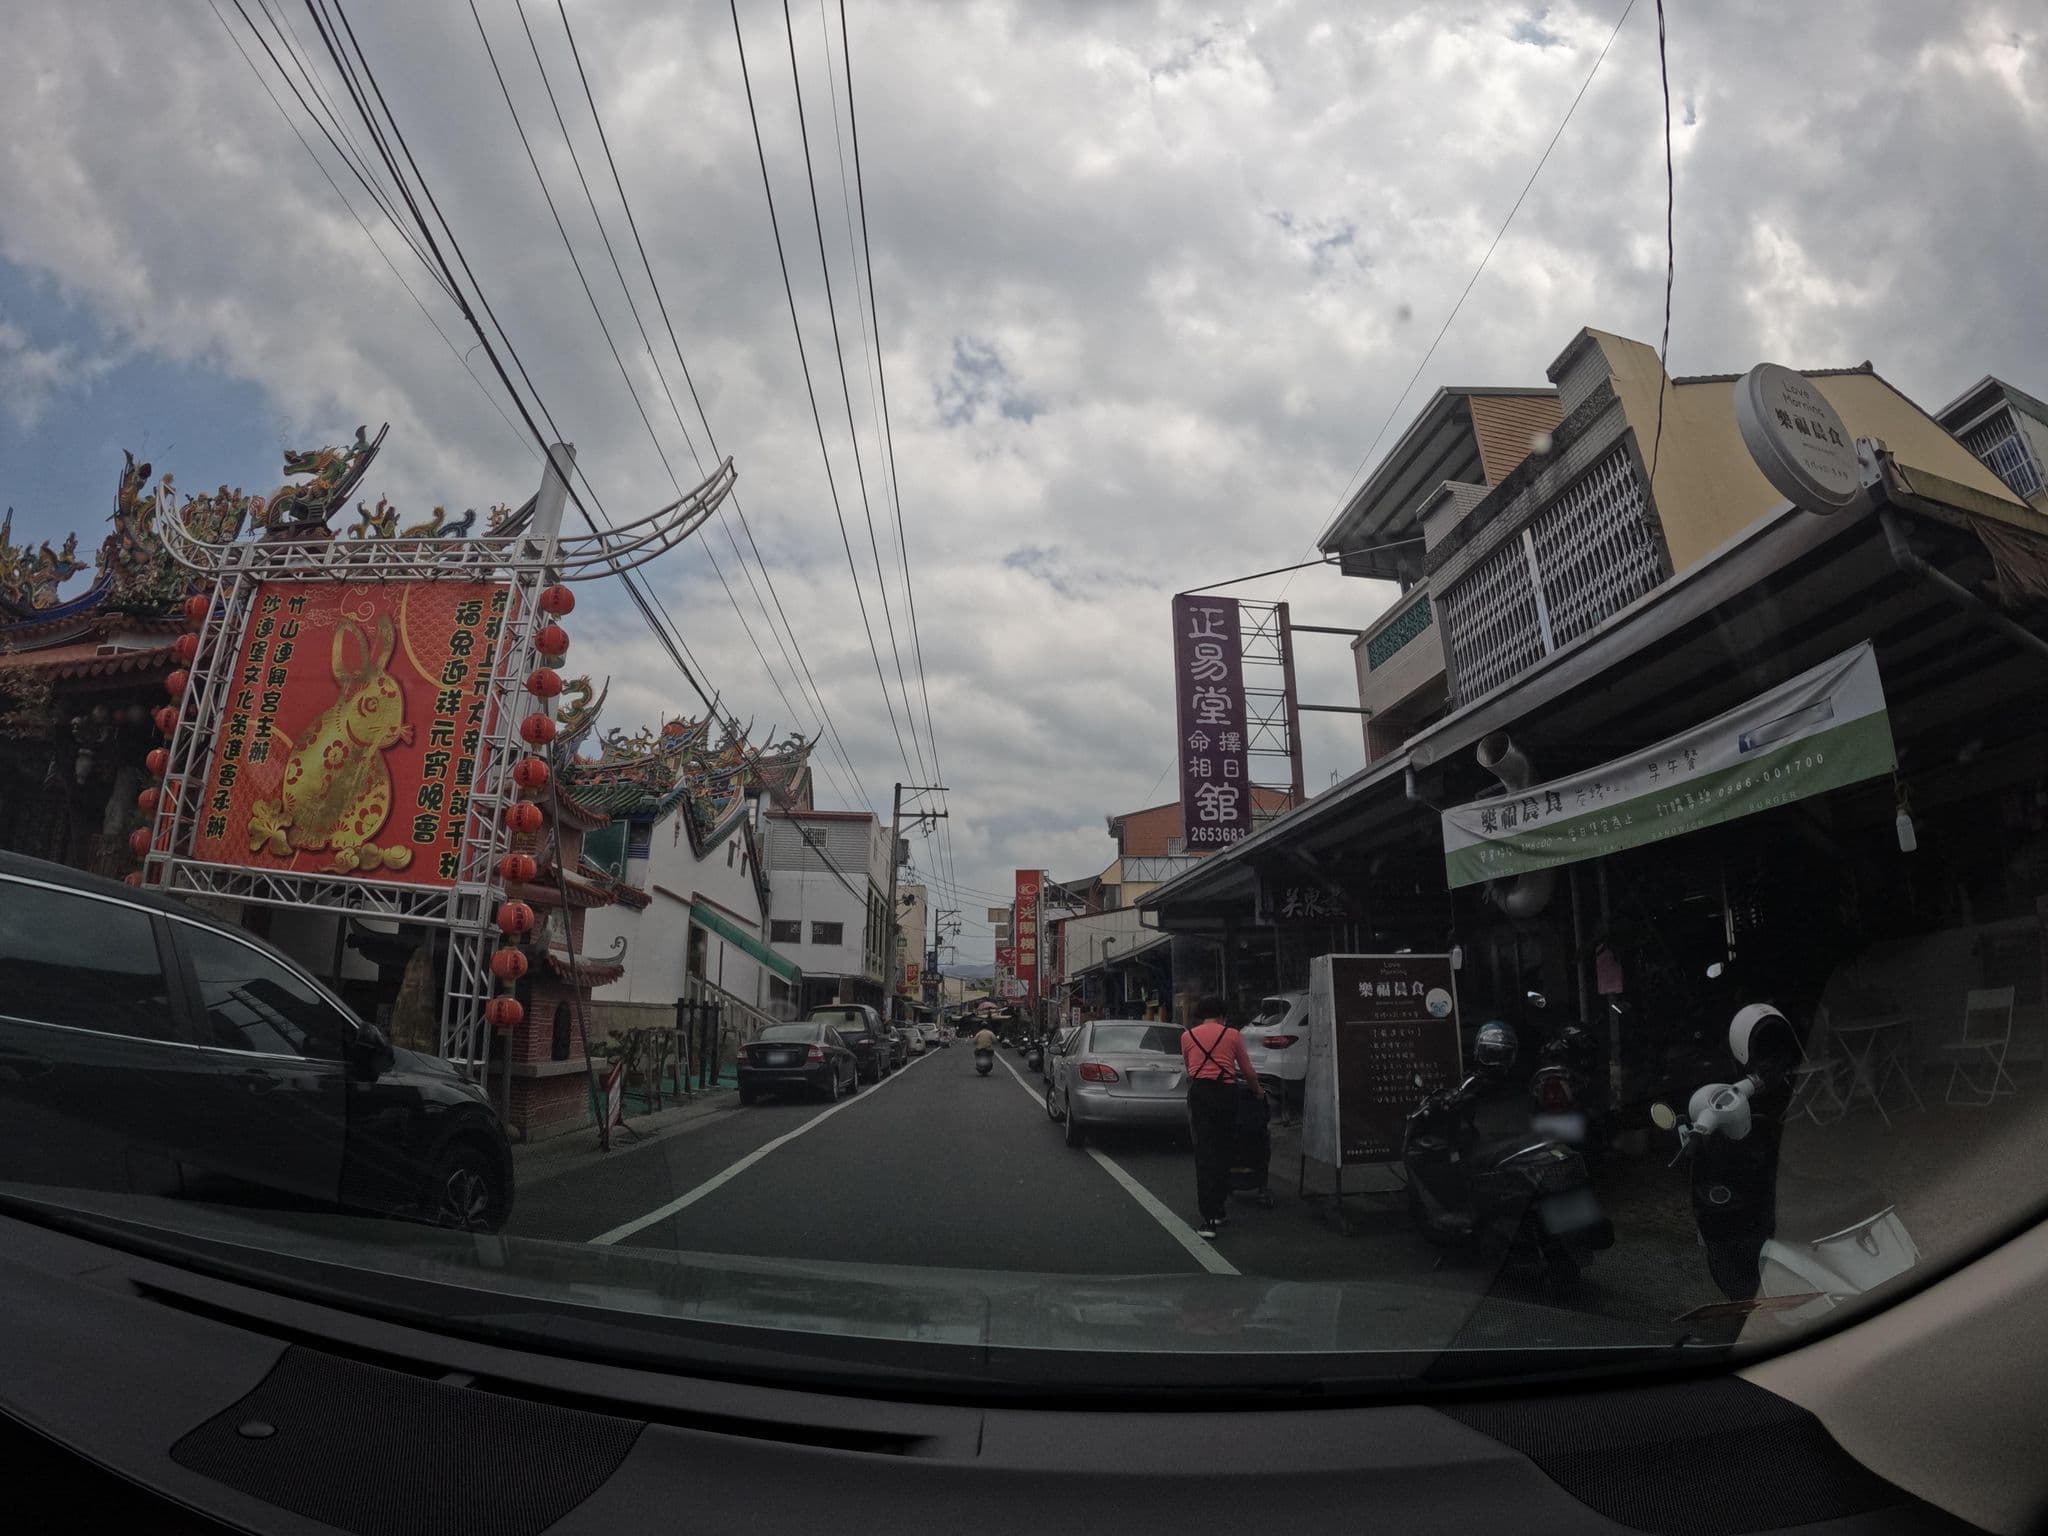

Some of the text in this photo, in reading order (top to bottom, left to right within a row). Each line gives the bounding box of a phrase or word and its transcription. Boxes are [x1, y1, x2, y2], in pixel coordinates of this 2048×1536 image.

[1774, 407, 1844, 448] 樂福晨食
[248, 595, 308, 765] 竹山連興宮主辦
[1187, 606, 1234, 726] 正易堂
[204, 594, 283, 841] 沙連堡文化策進會承辦
[412, 599, 484, 845] 福兔迎祥元宵晚會
[1187, 730, 1213, 779] 命相
[1219, 731, 1242, 779] 擇日
[1481, 790, 1564, 834] 樂福晨食
[1647, 748, 1699, 782] 早午餐
[1190, 826, 1246, 843] 2653683
[1358, 980, 1425, 998] 樂福晨食
